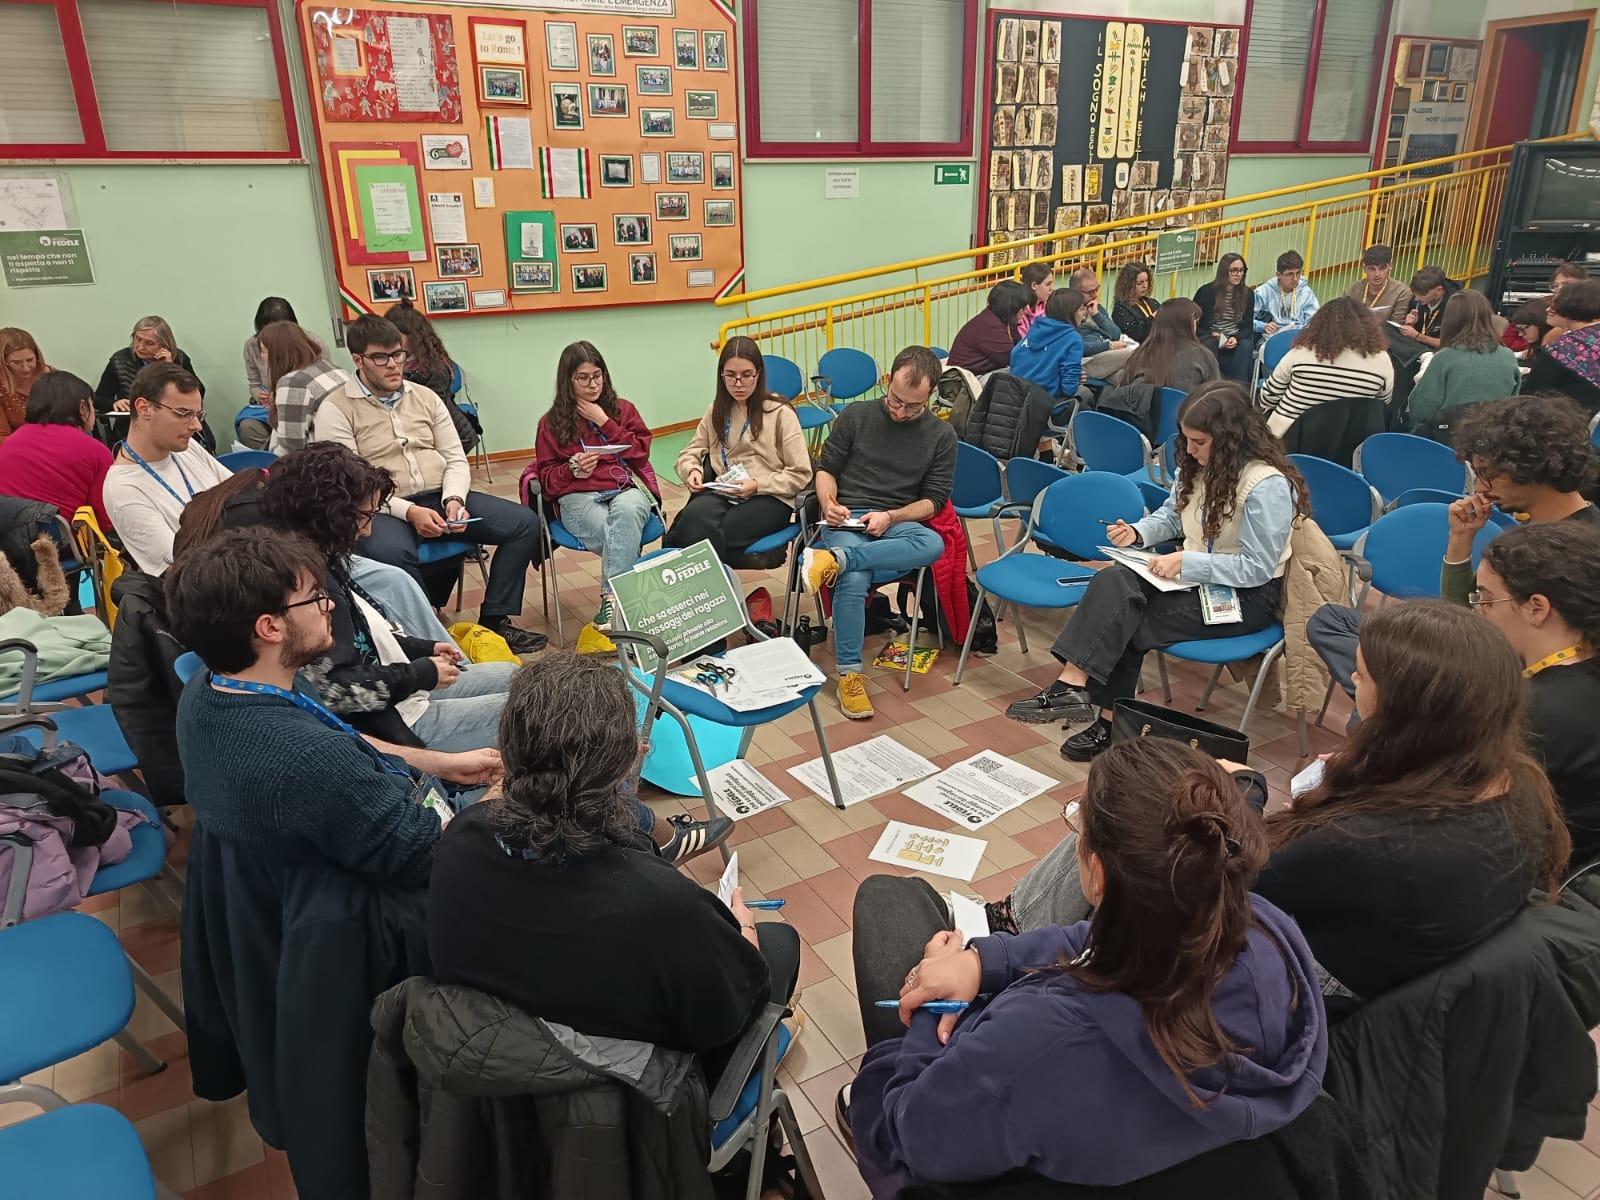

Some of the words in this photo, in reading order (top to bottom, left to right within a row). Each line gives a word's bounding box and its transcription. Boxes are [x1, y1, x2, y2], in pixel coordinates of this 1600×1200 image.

[480, 44, 488, 52] to
[505, 35, 516, 44] go
[1139, 36, 1151, 116] ANTICHI
[1090, 64, 1103, 123] SOGNO
[15, 260, 46, 268] aspetta
[20, 254, 46, 262] tempo
[677, 560, 711, 581] FEDELE
[638, 616, 656, 628] che
[656, 610, 667, 619] sa
[666, 596, 694, 615] esserci
[695, 589, 709, 601] nei
[682, 606, 695, 619] dei
[695, 592, 727, 613] ragazzi
[723, 788, 744, 805] FEDELE
[943, 801, 971, 815] FEDELE
